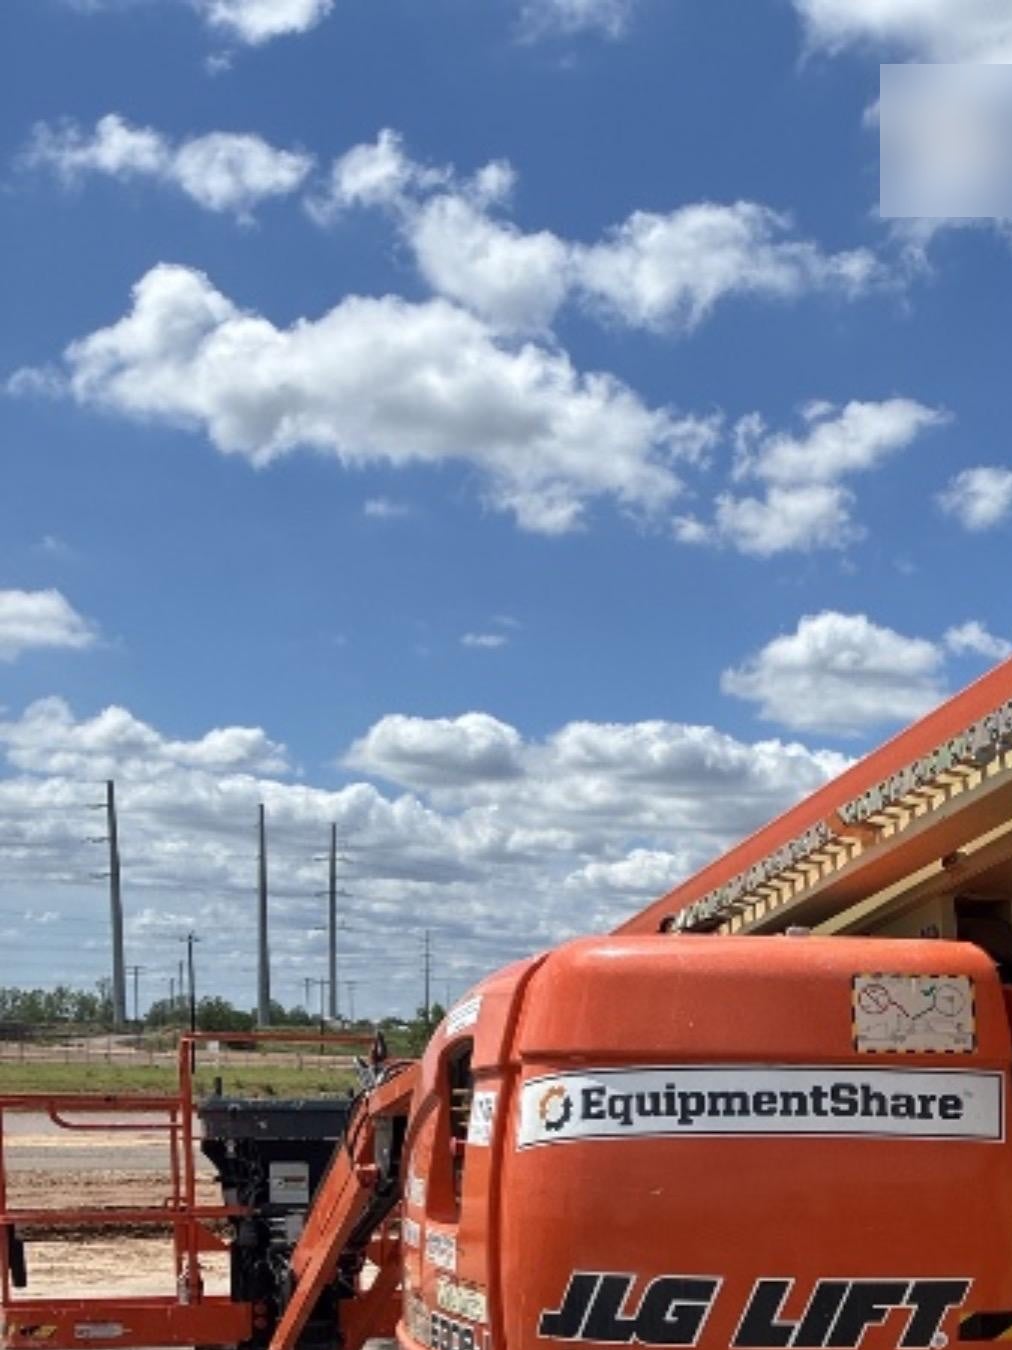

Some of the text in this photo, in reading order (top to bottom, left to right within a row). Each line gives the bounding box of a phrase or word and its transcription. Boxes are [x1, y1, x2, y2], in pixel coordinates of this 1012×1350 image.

[580, 1082, 964, 1126] EquipmentShare
[537, 1269, 724, 1348] JLG
[728, 1276, 975, 1350] LIFT
